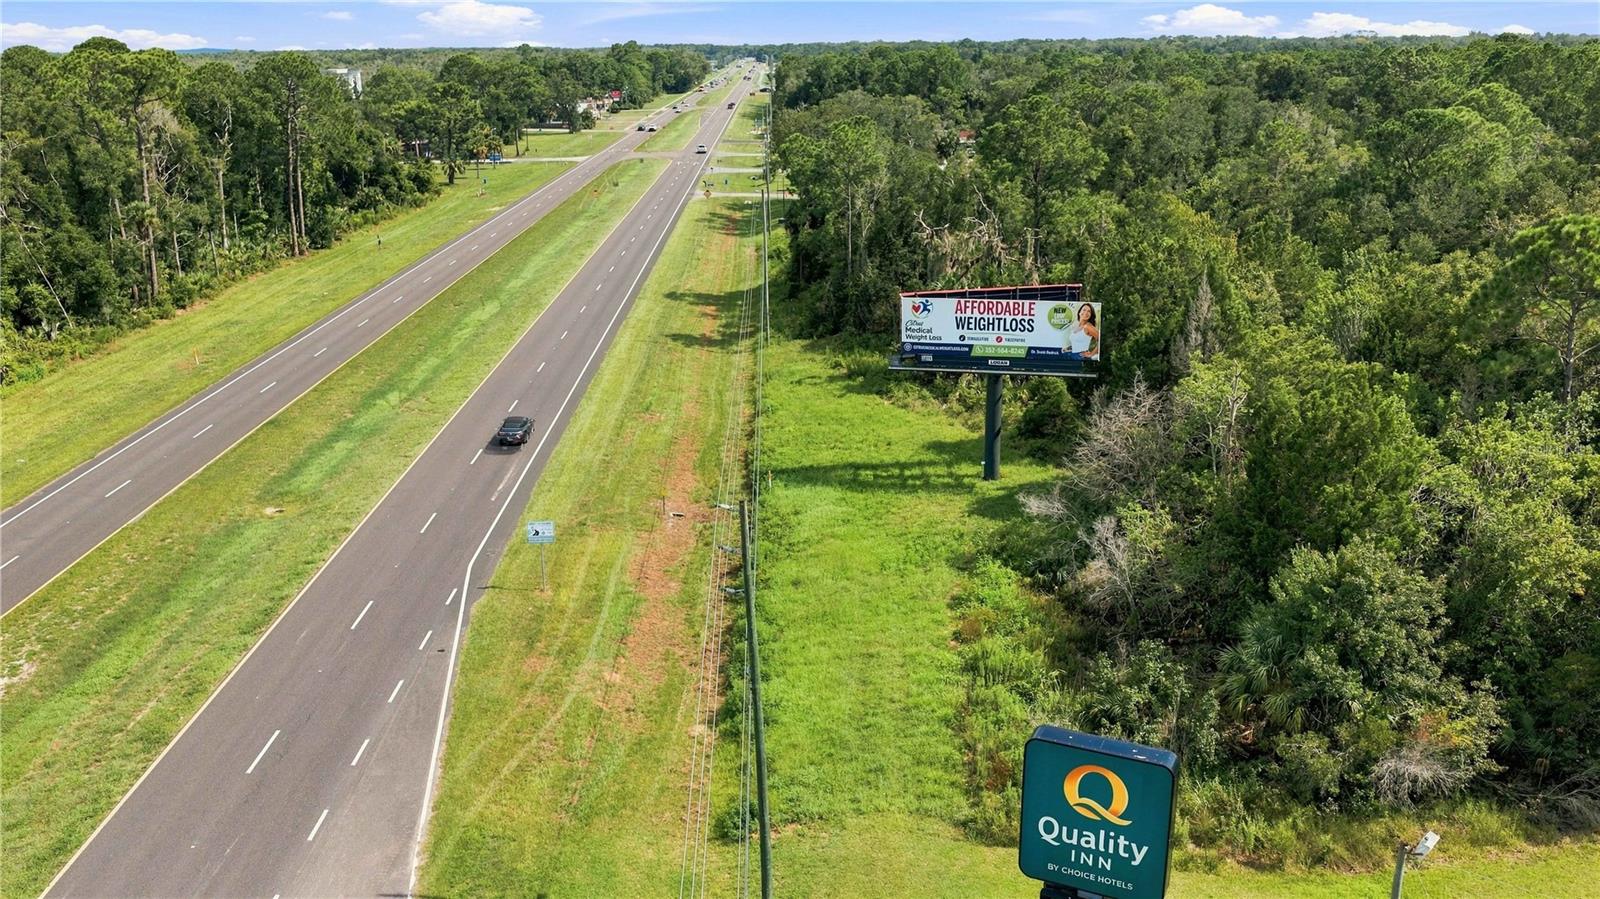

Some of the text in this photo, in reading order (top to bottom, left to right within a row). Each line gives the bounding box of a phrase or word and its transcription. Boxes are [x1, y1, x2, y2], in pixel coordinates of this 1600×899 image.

[955, 300, 1036, 317] AFFORDABLE
[955, 316, 1035, 332] WEIGHTLOSS
[1063, 764, 1133, 826] Q
[1038, 816, 1149, 866] Quality
[1071, 849, 1112, 871] INN
[1047, 863, 1134, 890] BY CHOICE HOTELS
